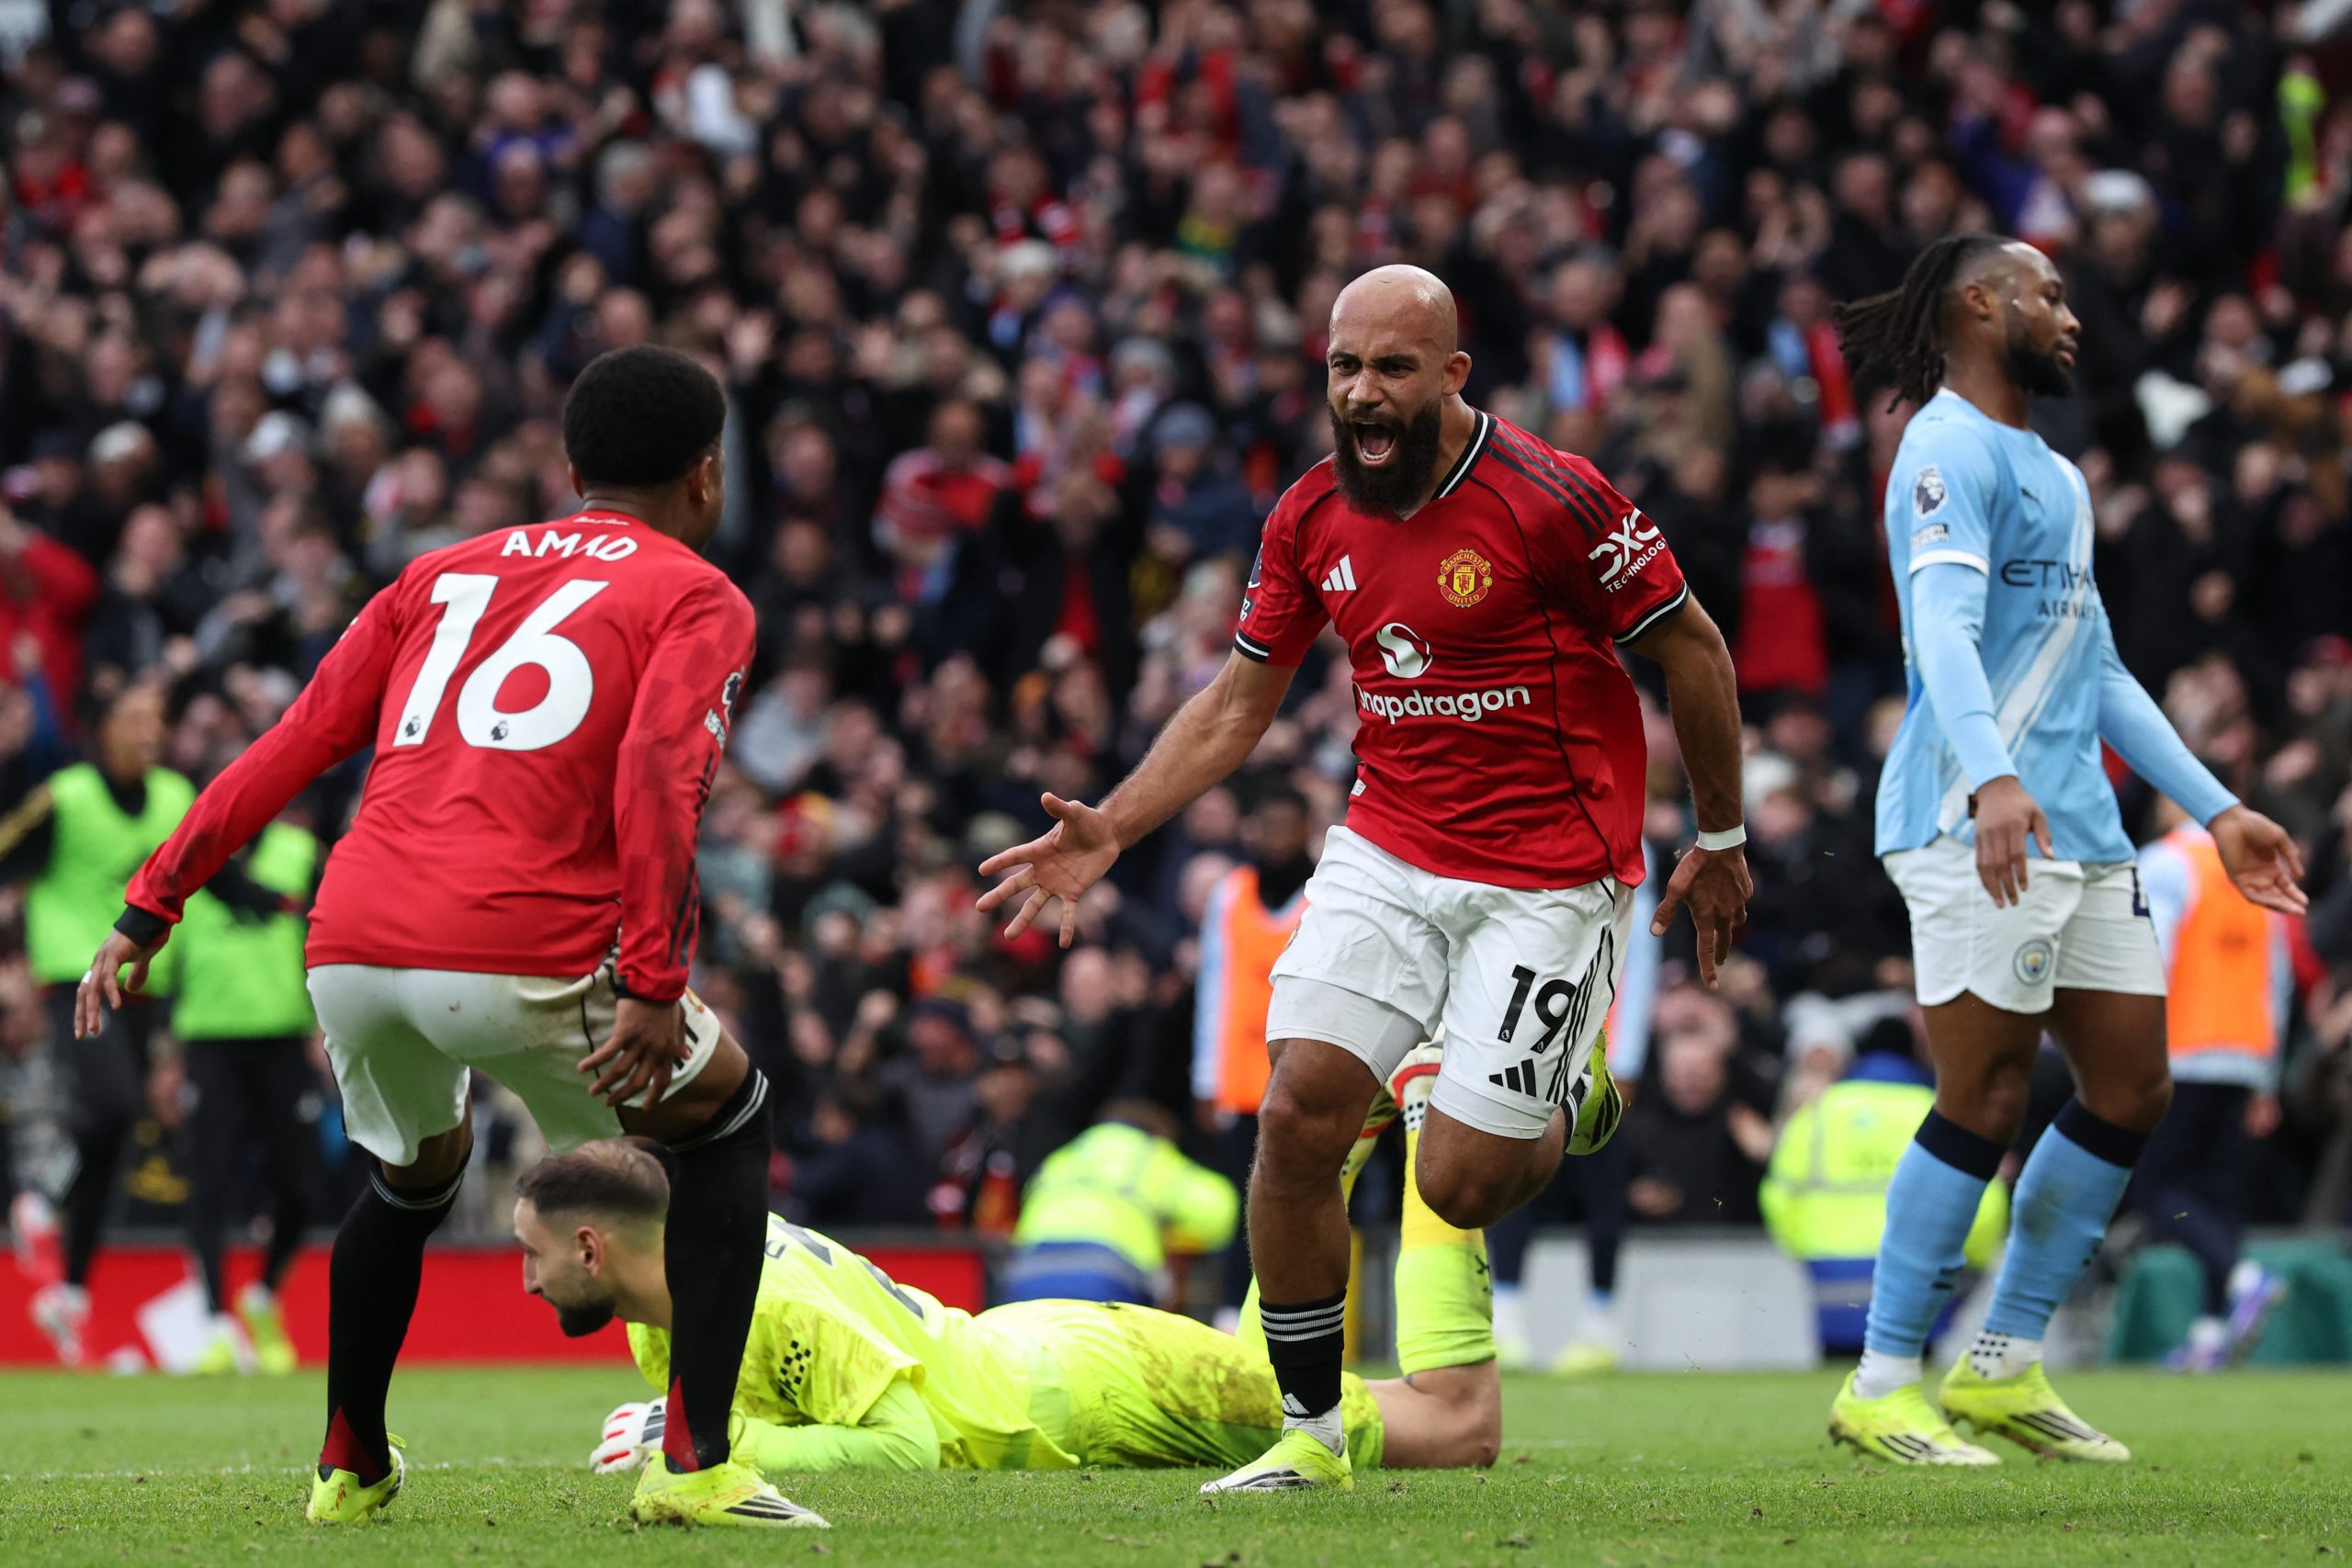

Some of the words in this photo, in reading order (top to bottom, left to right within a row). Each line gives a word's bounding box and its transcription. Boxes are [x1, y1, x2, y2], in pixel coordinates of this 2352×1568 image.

[1443, 553, 1487, 573] MANCHESTER
[2001, 559, 2096, 592] ETIHA
[1448, 593, 1480, 604] UNITED
[392, 572, 610, 751] 16
[1498, 964, 1577, 1055] 19
